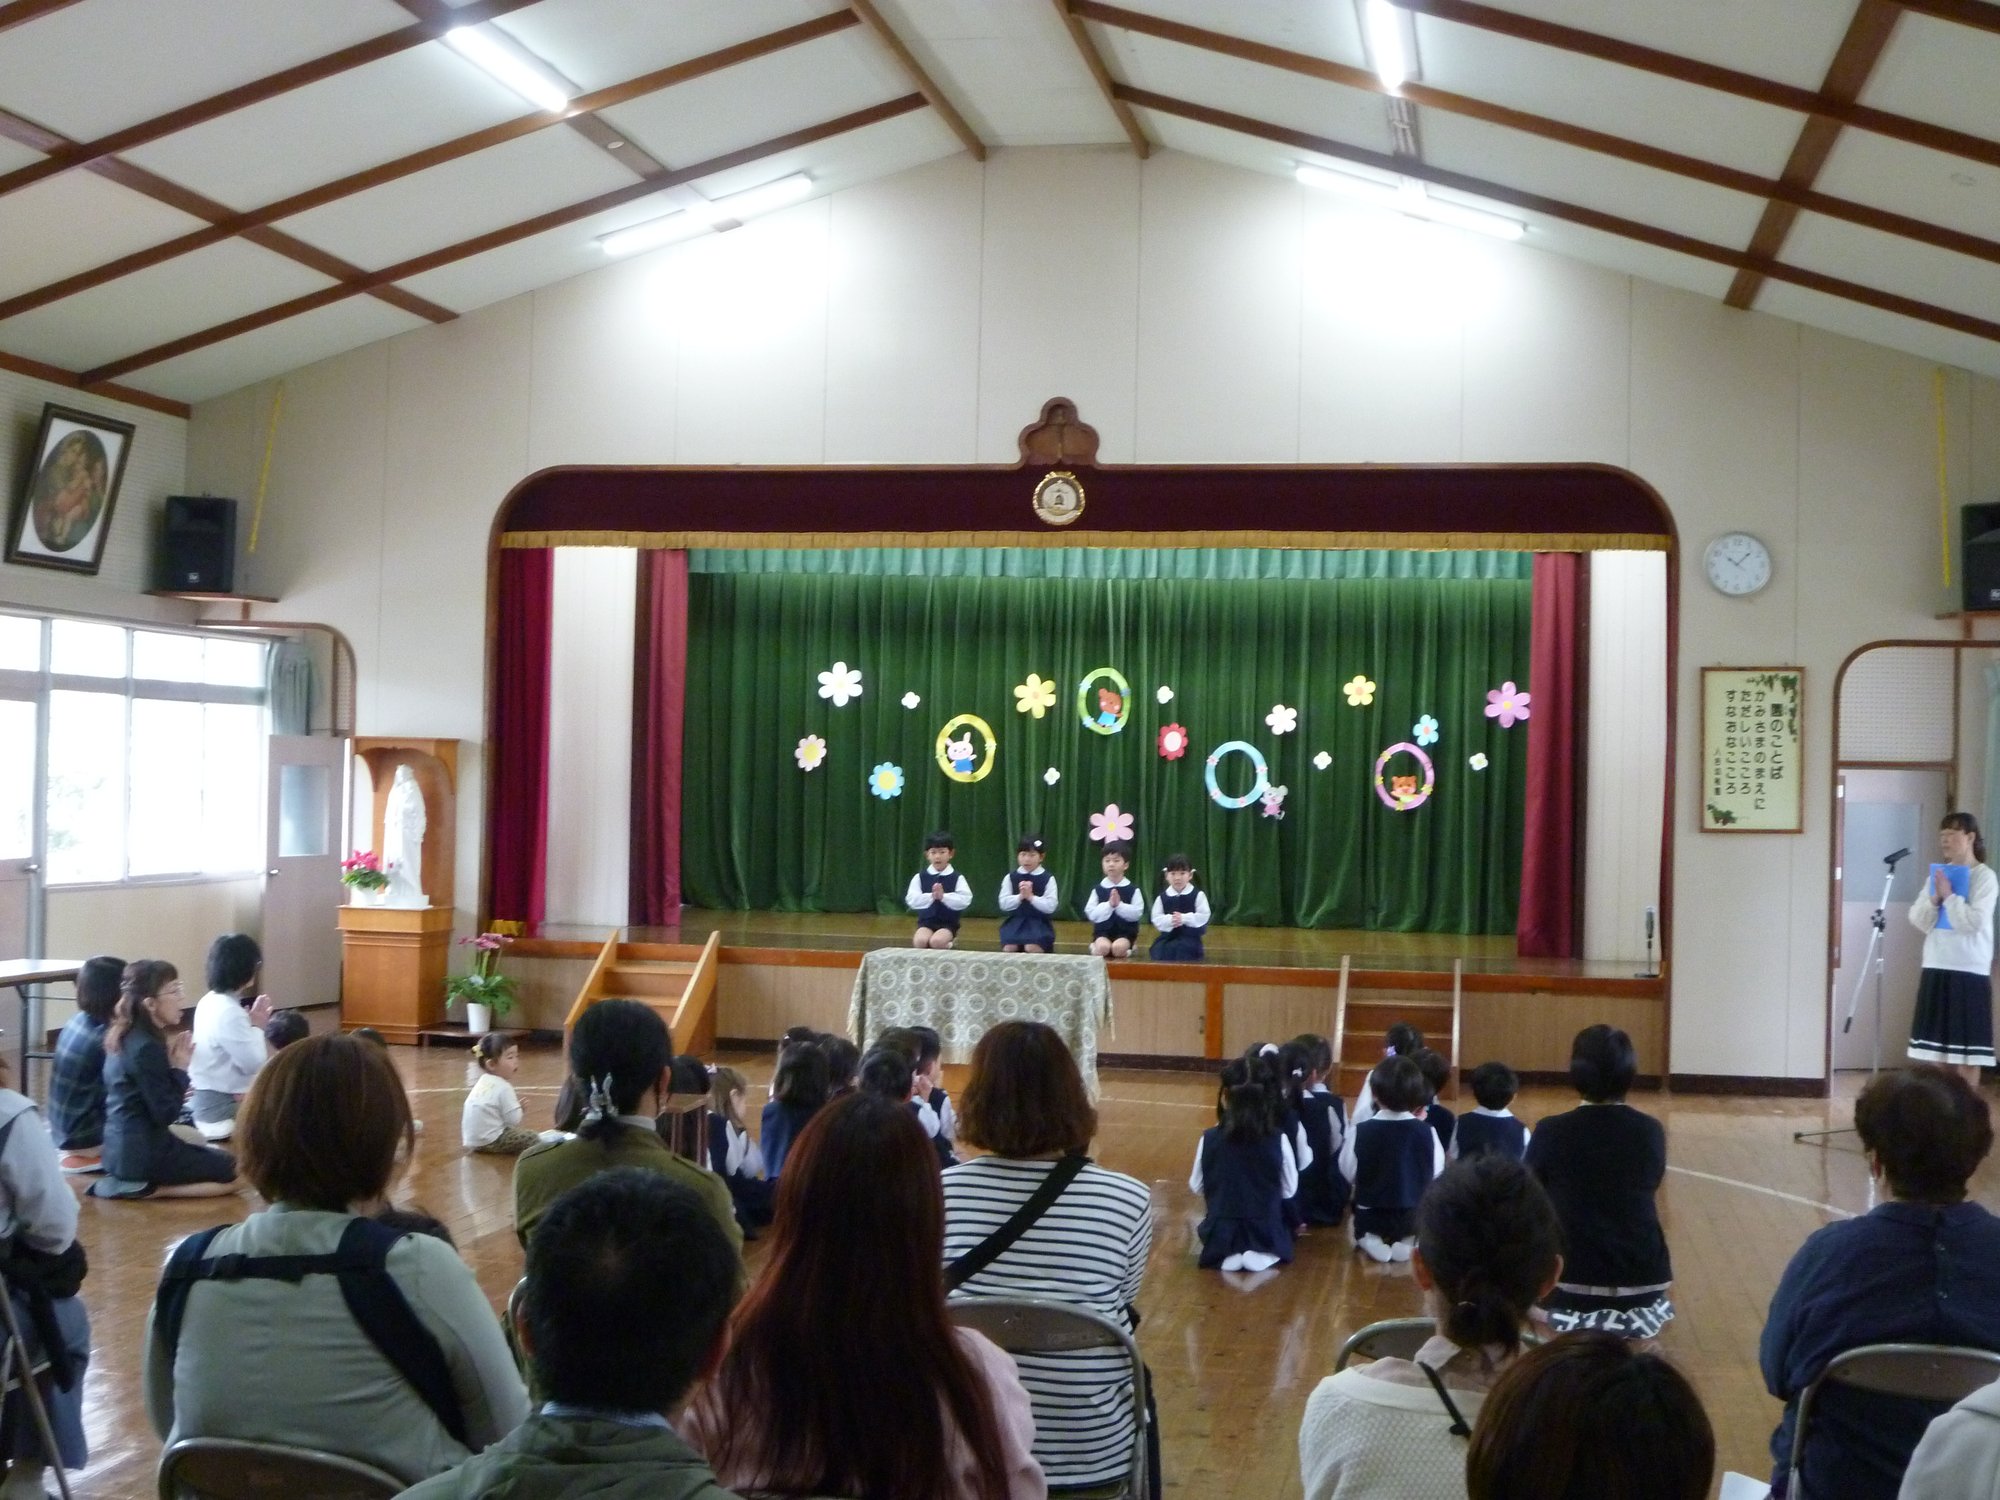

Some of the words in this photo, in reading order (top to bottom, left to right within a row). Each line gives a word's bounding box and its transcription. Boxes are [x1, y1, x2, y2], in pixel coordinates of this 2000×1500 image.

[1725, 690, 1737, 795] すなおなこころ
[1740, 690, 1751, 795] ただしいこころ
[1754, 690, 1766, 810] かみさまのまえに
